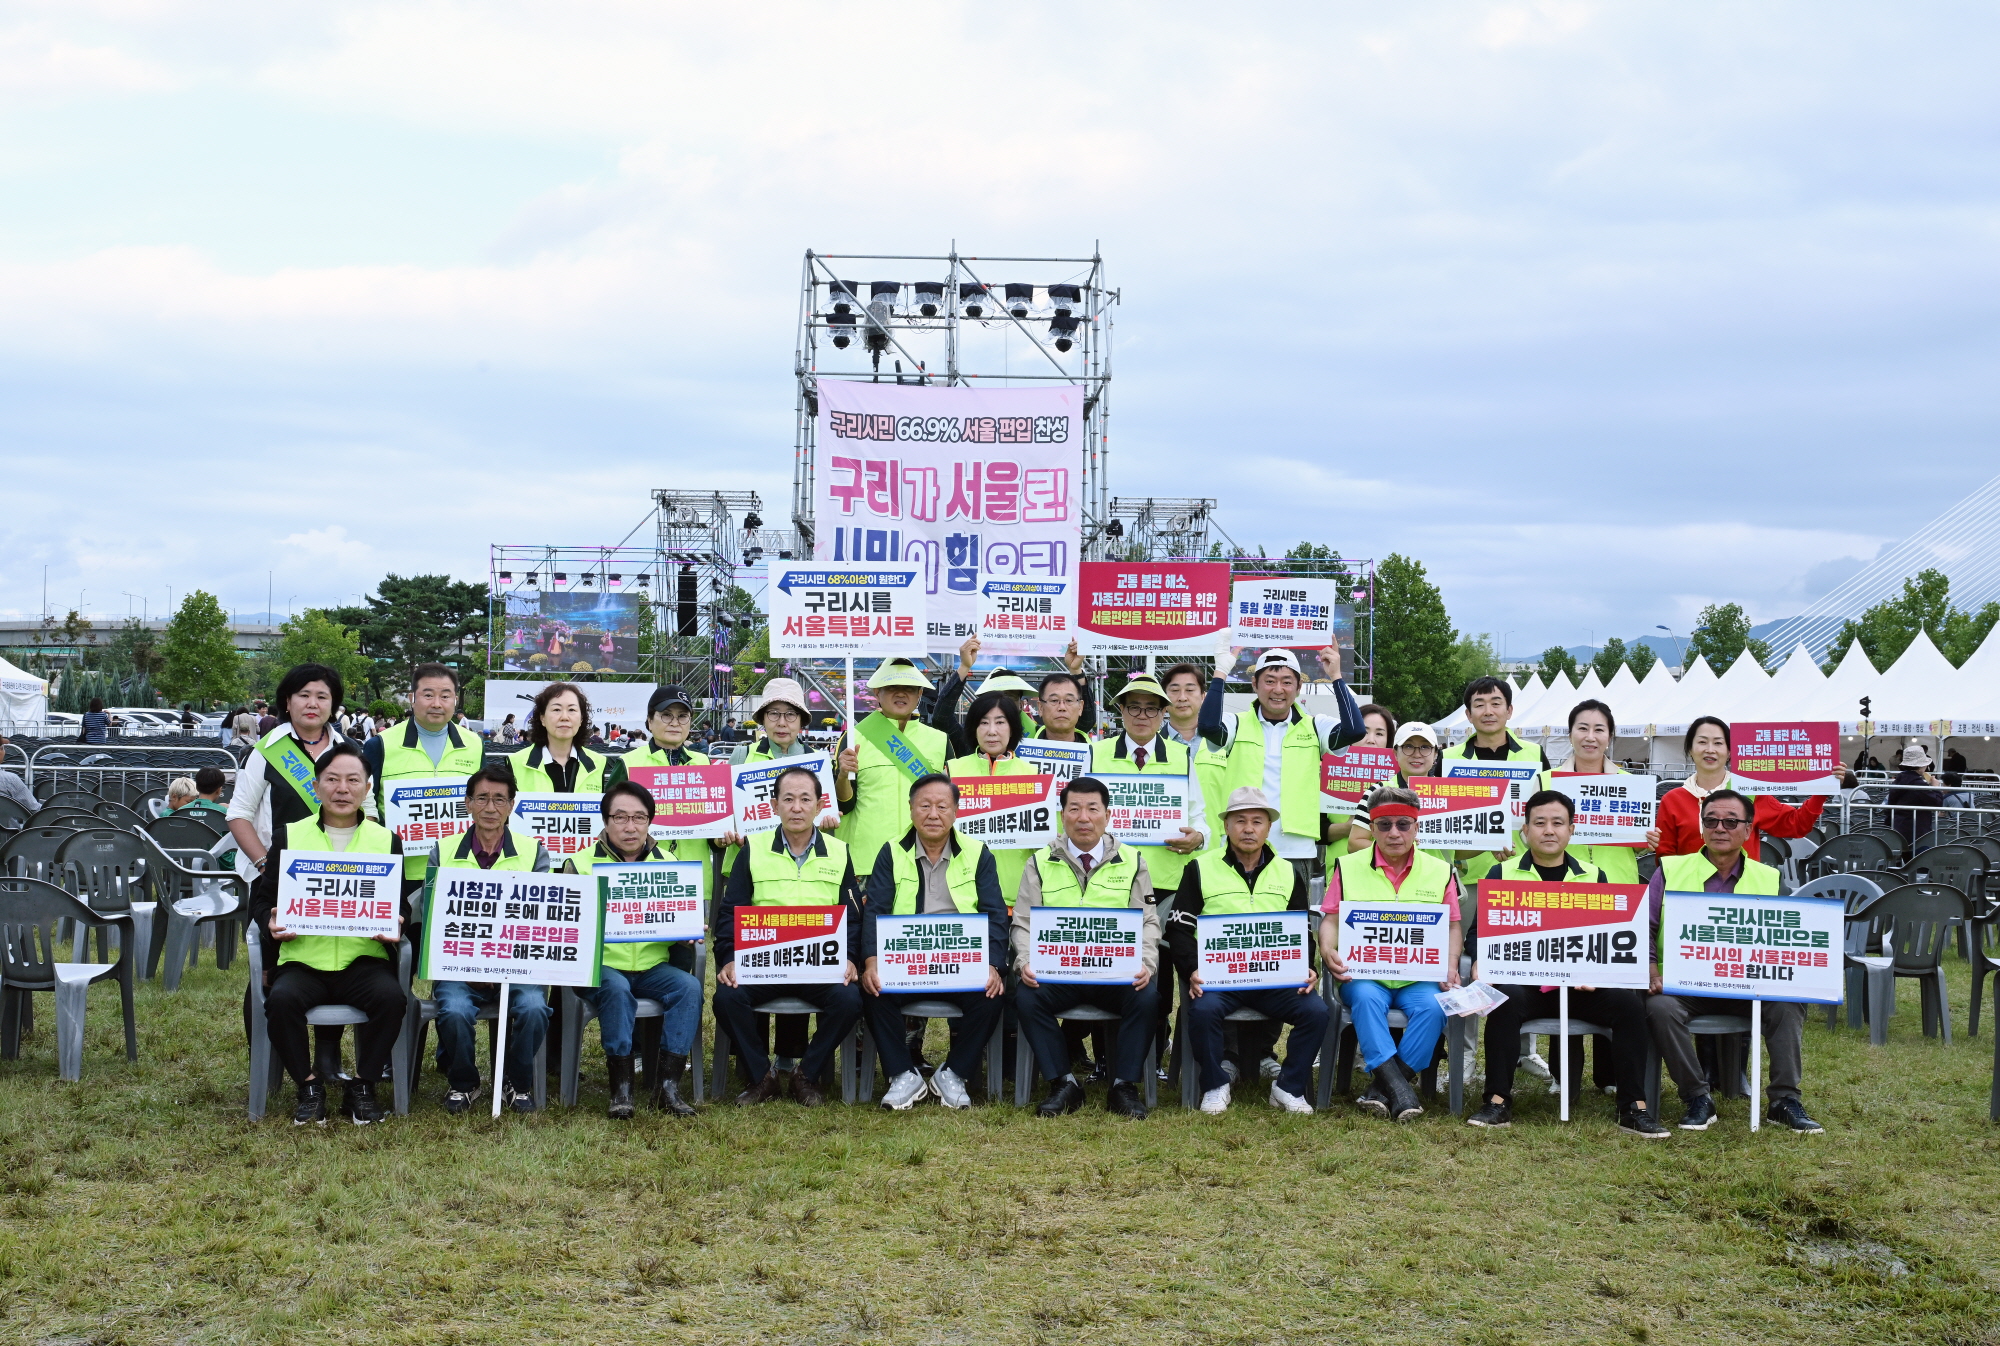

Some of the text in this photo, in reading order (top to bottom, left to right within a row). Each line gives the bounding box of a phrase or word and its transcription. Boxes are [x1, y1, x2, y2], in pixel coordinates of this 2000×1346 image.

[831, 411, 1069, 442] 구리시민 66.9% 서울 편입 찬성
[829, 455, 1068, 524] 구리가 서울로!
[789, 574, 906, 584] 구리시민 68%이상이 원한다
[1117, 574, 1189, 589] 교통 불편 해소,
[1092, 592, 1217, 607] 자족도시로의 발전을 위한
[1263, 589, 1306, 601] 구리시민은
[805, 592, 891, 613] 구리시를
[997, 597, 1052, 613] 구리시를
[1240, 602, 1328, 617] 동일 생활 문화권인
[984, 614, 1066, 631] 서울특별시로
[1091, 611, 1217, 625] 서울편입을 적극지지합니다
[1239, 617, 1328, 630] 서울로의 편입을 희망한다
[783, 616, 914, 637] 서울특별시로
[1756, 729, 1809, 741] 교통 불편 해소,
[886, 735, 914, 763] 서울
[1020, 748, 1043, 756] 구리시민
[1738, 744, 1832, 756] 자족도시로의 발전을 위한
[281, 750, 310, 781] 서울
[1738, 759, 1832, 771] 서울편입을 적극지지합니다
[654, 772, 705, 785] 교통 불편 해소,
[742, 772, 766, 782] 구리시민
[1328, 766, 1371, 779] 자족도시로의
[1454, 768, 1477, 776] 구리시민
[1109, 783, 1164, 794] 구리시민을
[1327, 780, 1361, 792] 서울편입을
[1415, 784, 1498, 797] 구리·서울통합특별법을
[1580, 785, 1627, 798] 구리시민은
[398, 790, 422, 798] 구리시민
[424, 788, 457, 796] 68%이상이
[685, 787, 725, 799] 발전을 위한
[582, 803, 600, 811] 원한다
[676, 802, 727, 814] 적극지지합니다
[959, 797, 990, 809] 통과시켜
[1581, 799, 1651, 814] 생활 문화권인
[409, 801, 469, 821] 구리시를
[1134, 810, 1181, 819] 서울편입을
[532, 817, 591, 834] 구리시를
[969, 807, 1049, 834] 염원을 이뤄주세요
[1113, 819, 1161, 829] 염원합니다
[1425, 811, 1504, 834] 염원을 이뤄주세요
[1590, 815, 1650, 827] 편입을 희망한다
[296, 862, 387, 874] 구리시민 68%이상이 원한다
[618, 872, 678, 885] 구리시민을
[306, 878, 376, 898] 구리시를
[447, 881, 581, 904] 시청과 시의회는
[647, 900, 696, 912] 서울편입을
[1488, 891, 1628, 911] 구리·서울통합특별법을
[286, 898, 392, 919] 서울특별시로
[446, 900, 581, 922] 시민의 뜻에 따라
[624, 912, 675, 924] 염원합니다
[741, 914, 832, 926] 구리·서울통합특별법을
[1056, 917, 1117, 930] 구리시민을
[1353, 912, 1378, 921] 구리시민
[1380, 913, 1414, 922] 68%이상이
[1488, 910, 1541, 927] 통과시켜
[1708, 907, 1801, 928] 구리시민을
[445, 922, 579, 943] 손잡고 서울편입을
[741, 929, 776, 941] 통과시켜
[902, 924, 963, 937] 구리시민을
[1223, 922, 1282, 936] 구리시민을
[1038, 930, 1136, 943] 서울특별시민으로
[1205, 934, 1301, 950] 서울특별시민으로
[1363, 927, 1424, 945] 구리시를
[1680, 924, 1829, 948] 서울특별시민으로
[443, 940, 578, 961] 적극 추진해주세요
[884, 937, 982, 951] 서울특별시민으로
[1488, 930, 1637, 964] 시민 염원을 이뤄주세요
[741, 940, 839, 967] 시민 염원을 이뤄주세요
[1038, 945, 1135, 957] 구리시의 서울편입을
[1206, 949, 1301, 963] 구리시의 서울편입을
[1347, 946, 1439, 964] 서울특별시로
[1680, 945, 1828, 967] 구리시의 서울편입을
[885, 952, 982, 964] 구리시의 서울편입을
[1061, 957, 1112, 967] 염원합니다
[908, 964, 960, 975] 염원합니다
[1228, 961, 1279, 973] 염원합니다
[1714, 963, 1794, 981] 염원합니다
